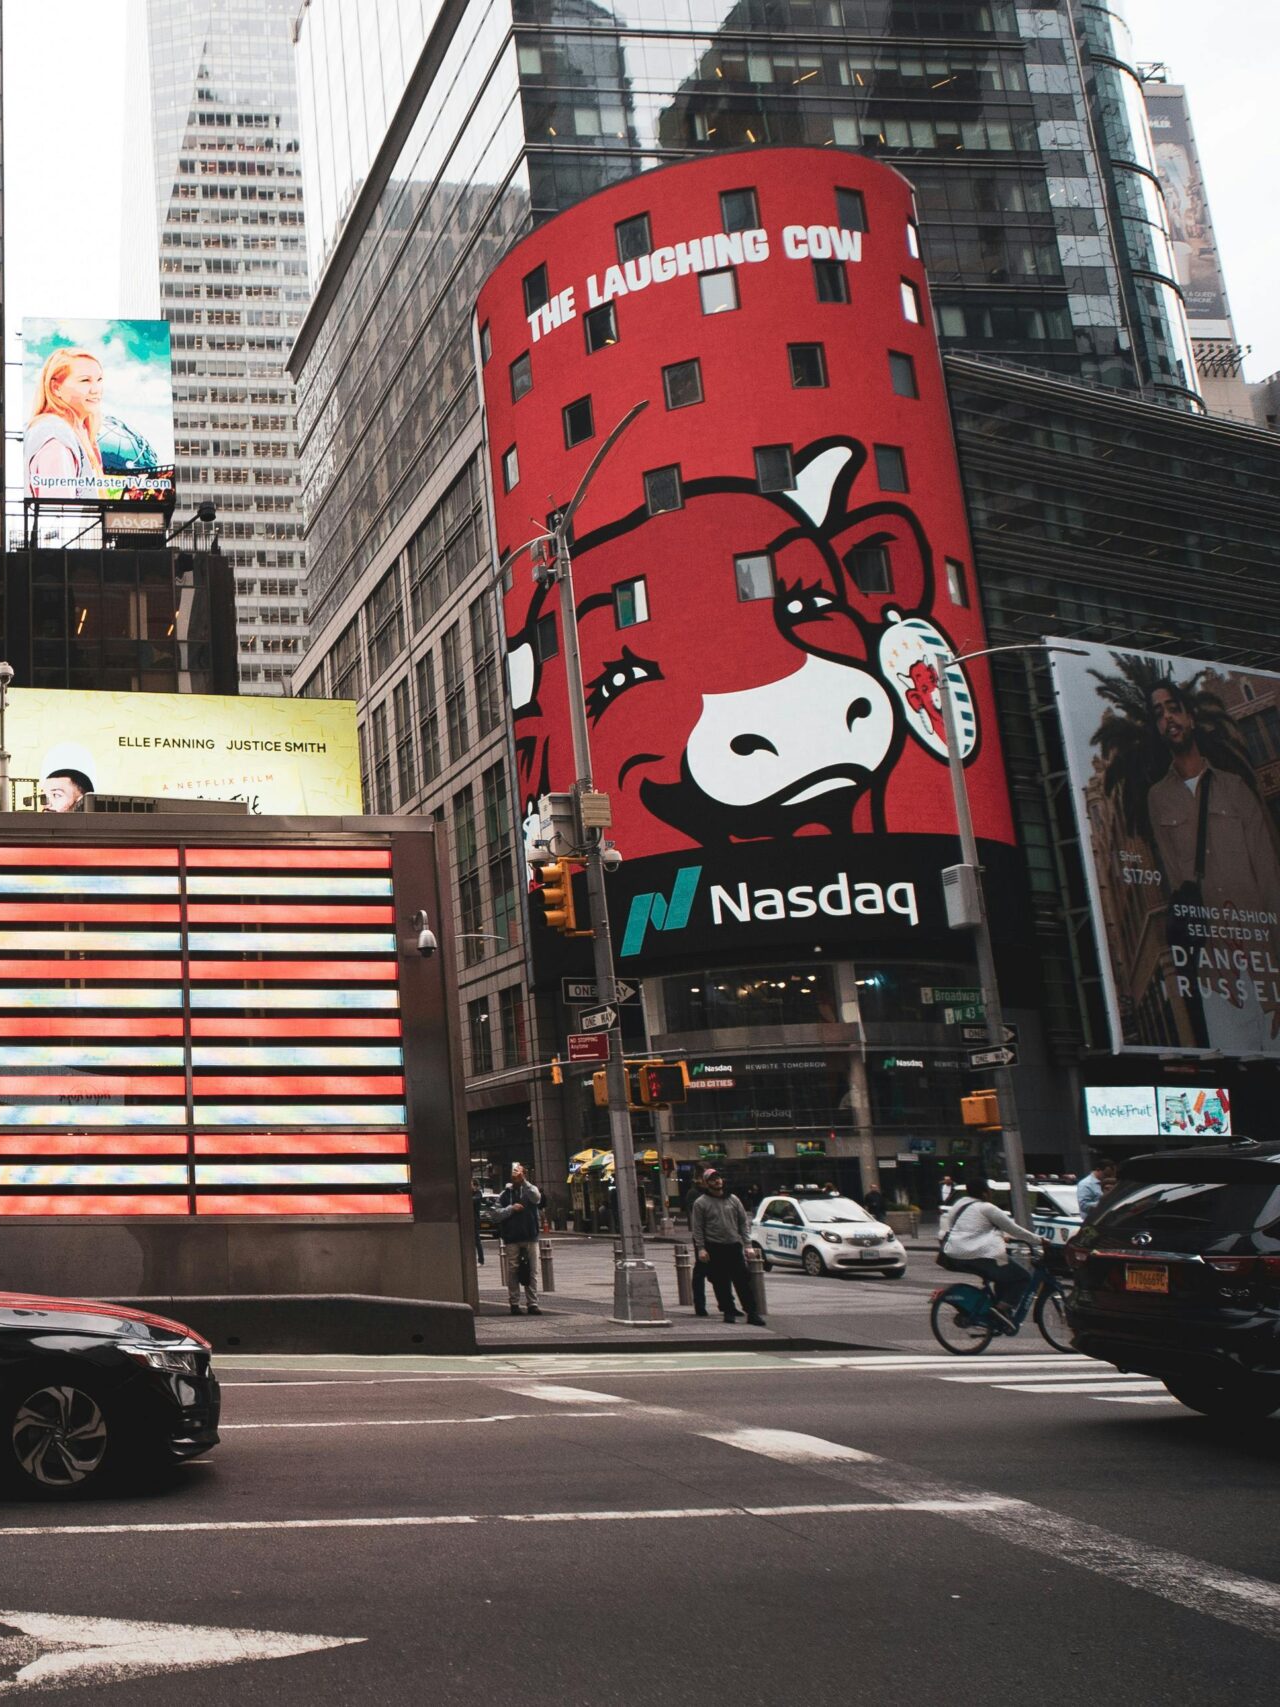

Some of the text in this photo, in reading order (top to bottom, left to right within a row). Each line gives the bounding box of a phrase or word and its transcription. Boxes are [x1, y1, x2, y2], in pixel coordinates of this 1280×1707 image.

[527, 225, 863, 343] THE LAUGHING COW
[33, 476, 171, 489] SupremeMasterTV.com
[118, 736, 327, 754] ELLE FANNING JUSTICE SMITH
[177, 777, 234, 789] NETFLIX
[243, 774, 274, 783] FILM
[1120, 851, 1143, 863] Shirt
[1123, 867, 1162, 886] $17.99
[710, 872, 919, 926] Nasdaq
[1173, 904, 1277, 925] SPRING FASHION
[1188, 923, 1270, 942] SELECTED BY
[575, 986, 628, 997] ONE AY
[935, 990, 980, 1005] Broadway
[585, 1012, 613, 1028] ONE WAY
[954, 1009, 962, 1021] W
[965, 1006, 976, 1019] 43
[969, 1030, 985, 1038] ONE
[896, 1058, 924, 1068] Nasdaq
[975, 1052, 1009, 1064] ONE WAY
[704, 1064, 733, 1073] Nasdaq
[782, 1061, 827, 1069] TOMORROW
[706, 1079, 734, 1088] CITIES
[751, 1109, 792, 1119] Nasdaq
[778, 1233, 798, 1250] NYPD
